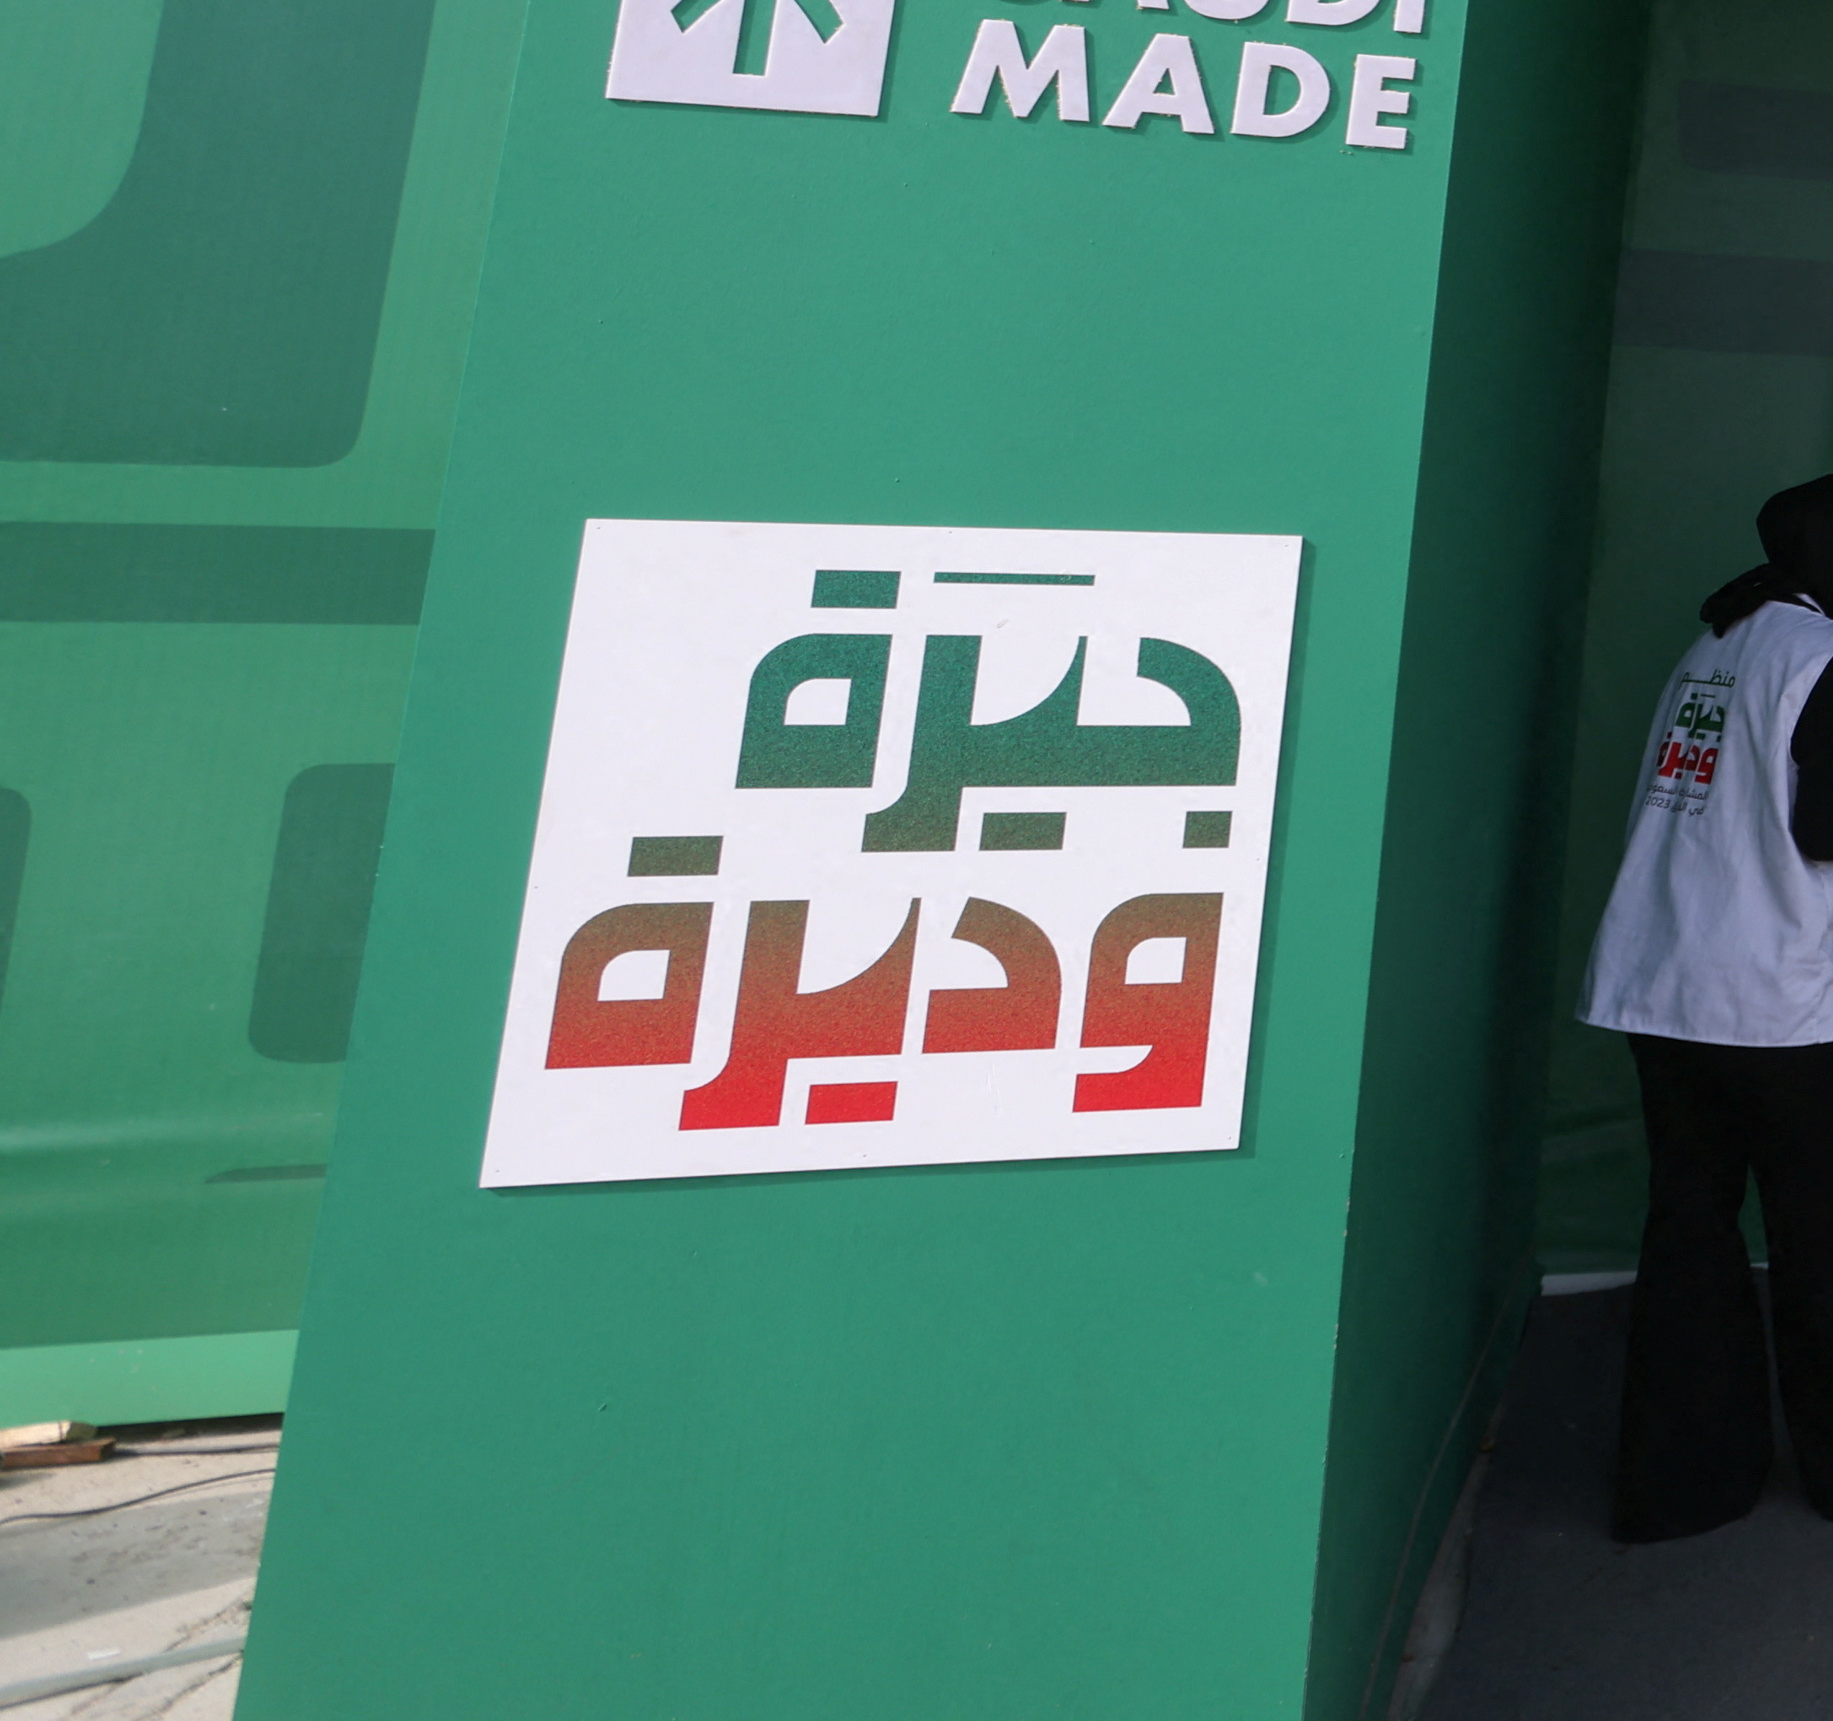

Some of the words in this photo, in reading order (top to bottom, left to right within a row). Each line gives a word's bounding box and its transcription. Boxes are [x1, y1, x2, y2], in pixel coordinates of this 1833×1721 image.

[950, 19, 1417, 150] MADE
[1678, 668, 1736, 690] منظم
[544, 836, 1224, 1132] وديرة
